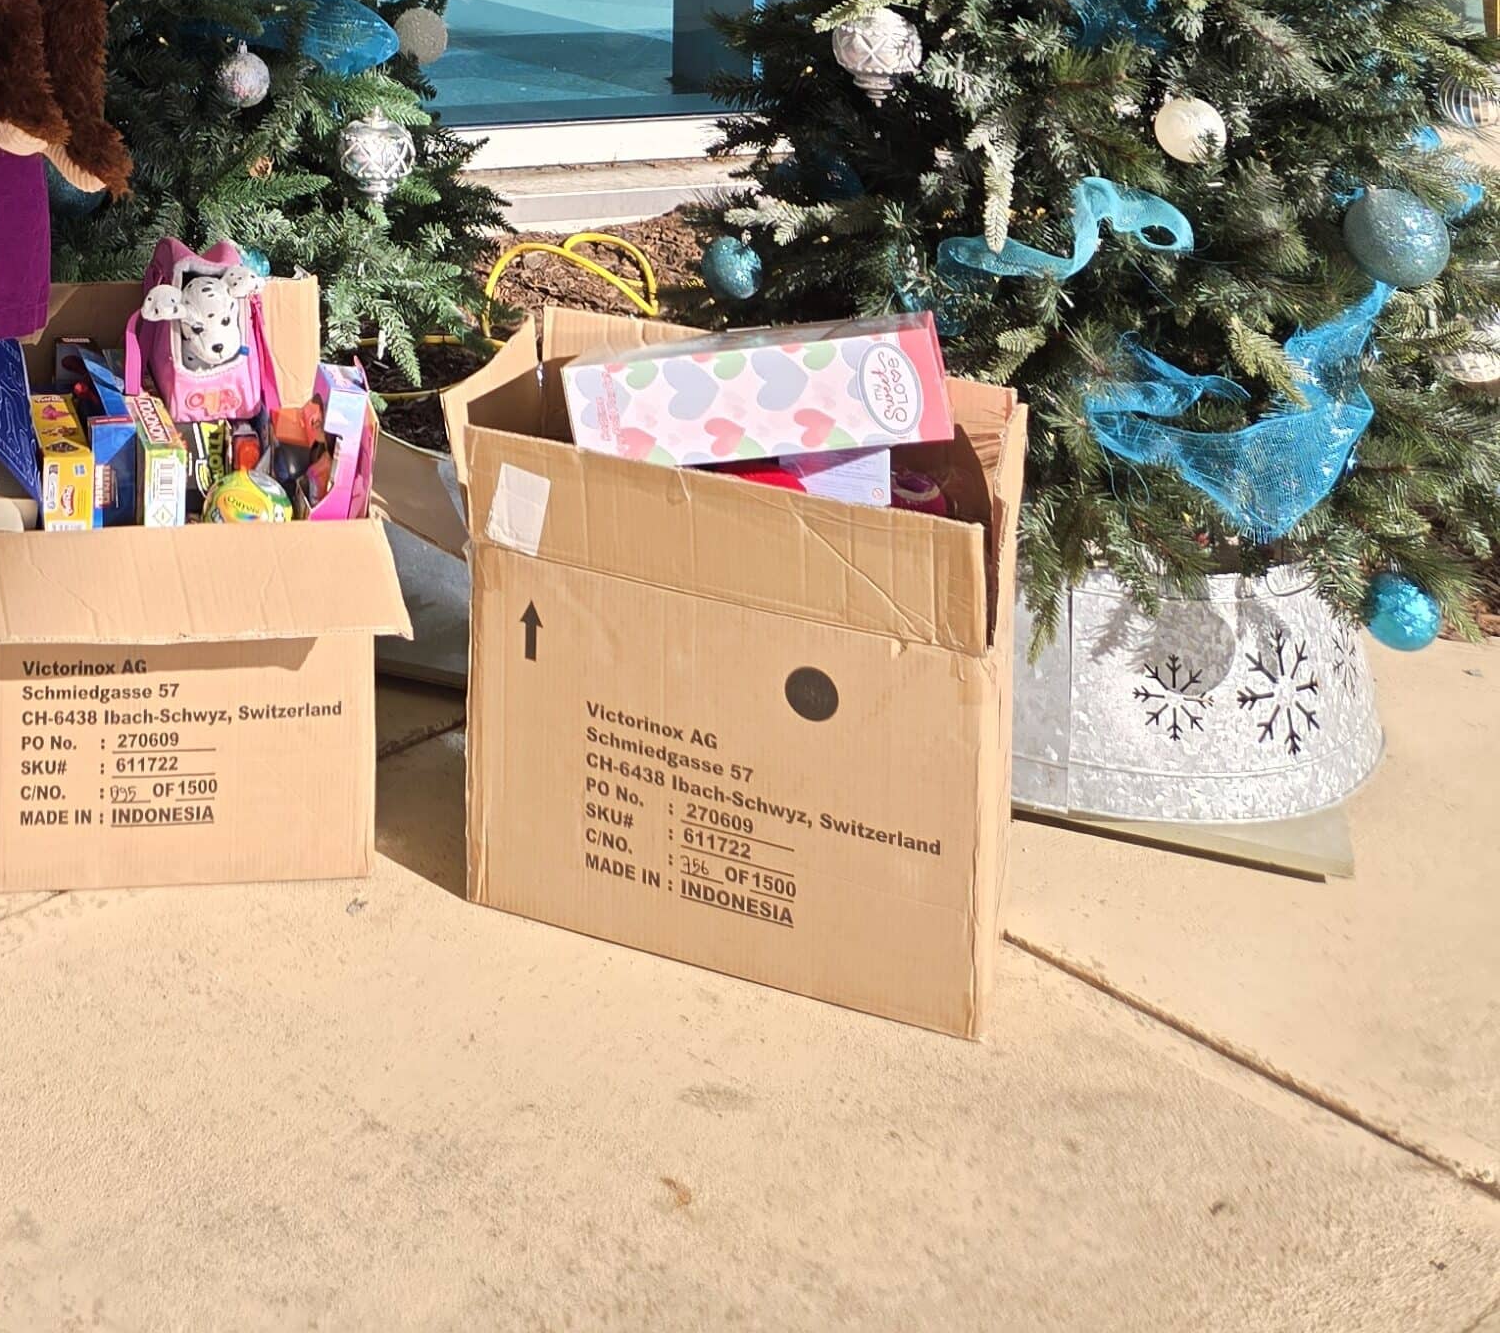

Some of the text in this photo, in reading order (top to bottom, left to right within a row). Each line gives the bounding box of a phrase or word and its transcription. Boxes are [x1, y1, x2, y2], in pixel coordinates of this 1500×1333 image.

[22, 659, 147, 676] Victorinox AG
[22, 684, 180, 703] Schmiedgasse 57
[22, 701, 342, 726] CH-6438 Ibach-Schwyz, Switzerland
[586, 700, 718, 750] Victorinox AG
[21, 735, 45, 751] PO
[50, 735, 77, 751] No.
[117, 732, 180, 749] 270609
[586, 727, 754, 783] Schmiedgasse 57
[20, 760, 68, 775] SKU#
[116, 757, 179, 773] 611722
[20, 785, 67, 801] C/NO.
[152, 782, 176, 798] OF
[177, 778, 218, 797] 1500
[586, 753, 941, 856] CH-6438 Ibach-Schwyz, Switzerland
[586, 777, 610, 797] PO
[615, 786, 644, 806] No.
[686, 803, 754, 834] 270609
[20, 809, 69, 825] MADE
[74, 809, 93, 824] IN
[111, 805, 215, 824] INDONESIA
[585, 804, 635, 829] SKU#
[683, 828, 751, 859] 611722
[585, 829, 633, 854] C/NO.
[724, 867, 750, 886] OF
[752, 872, 796, 898] 1500
[585, 854, 636, 881] MADE
[641, 868, 661, 889] IN
[681, 878, 794, 925] INDONESIA
